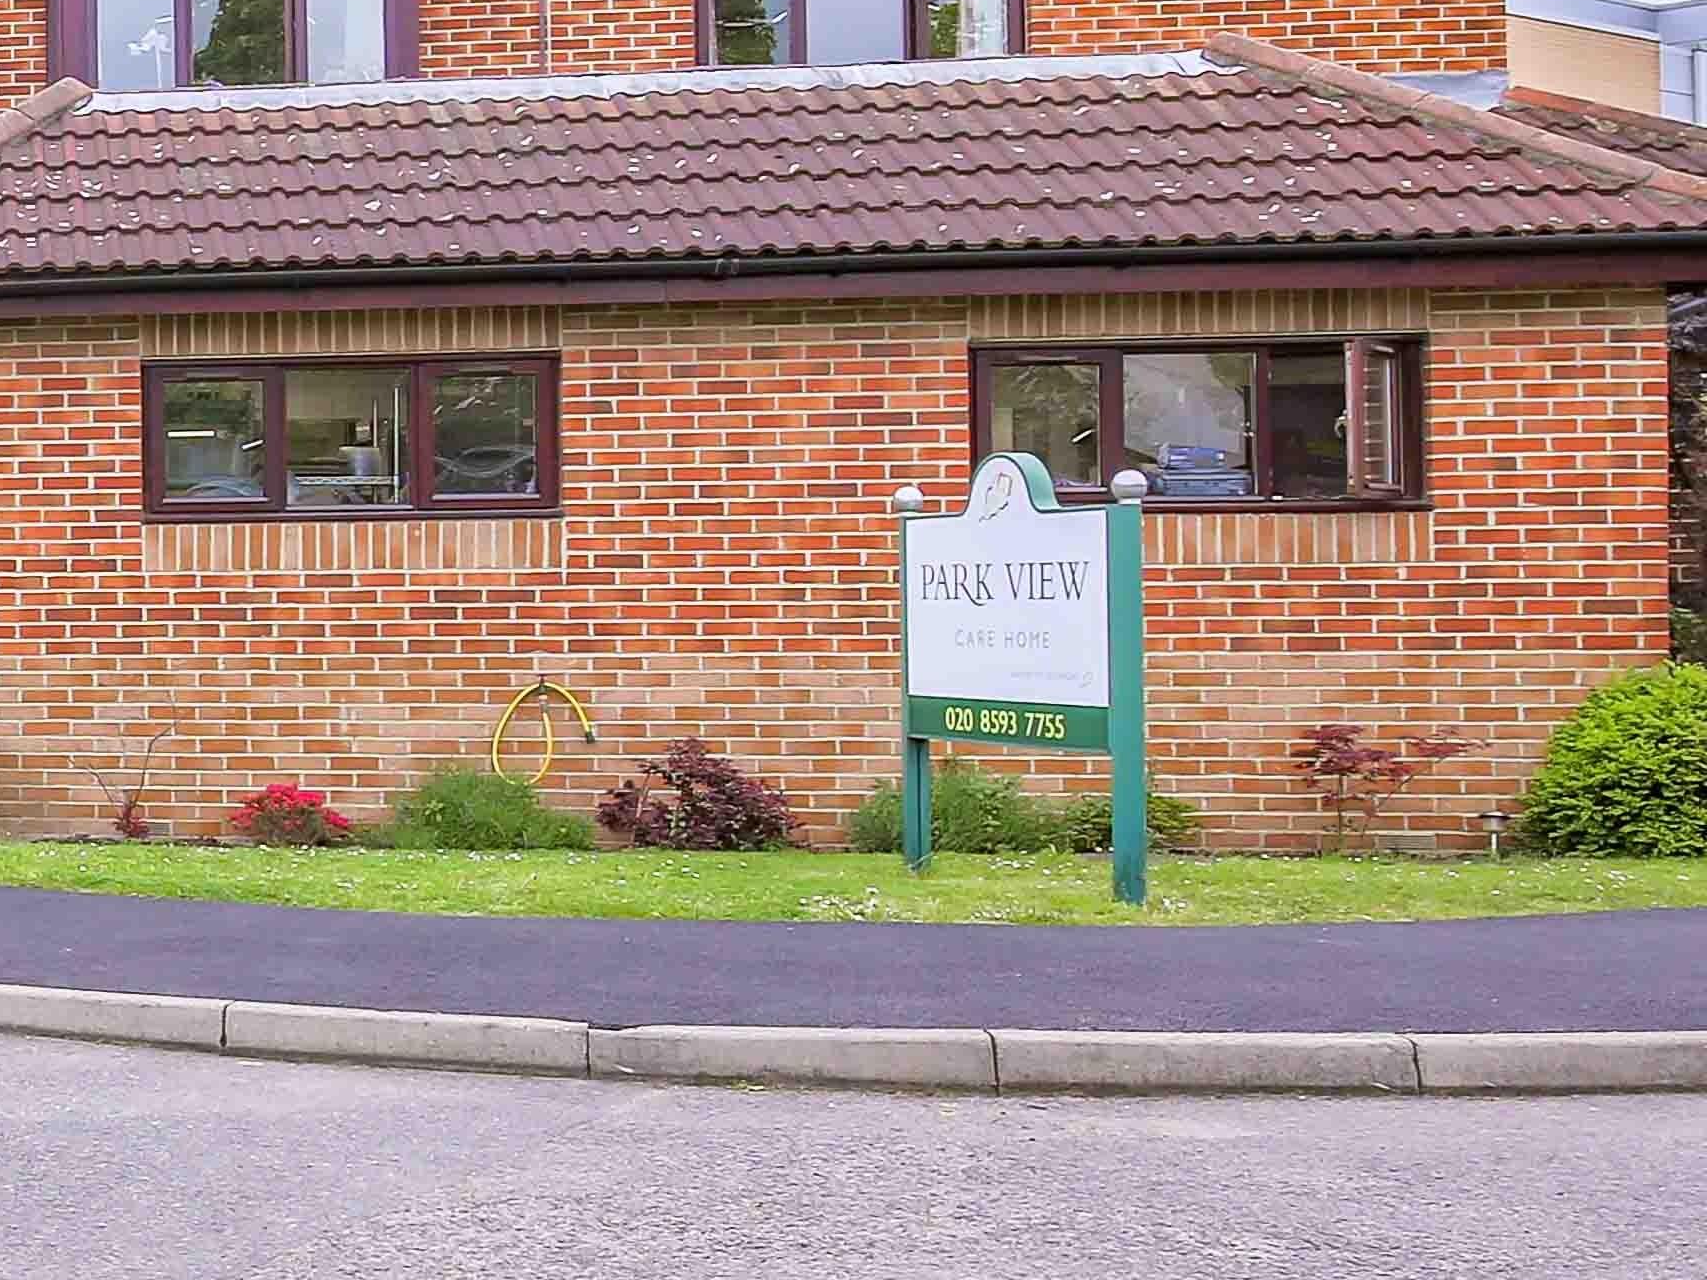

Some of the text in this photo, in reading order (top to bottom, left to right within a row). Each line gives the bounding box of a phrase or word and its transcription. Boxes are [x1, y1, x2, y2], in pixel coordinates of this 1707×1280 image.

[920, 560, 1090, 606] PARK VIEW
[954, 628, 1051, 650] CARE HOME
[945, 705, 1065, 740] 020 8593 7755
